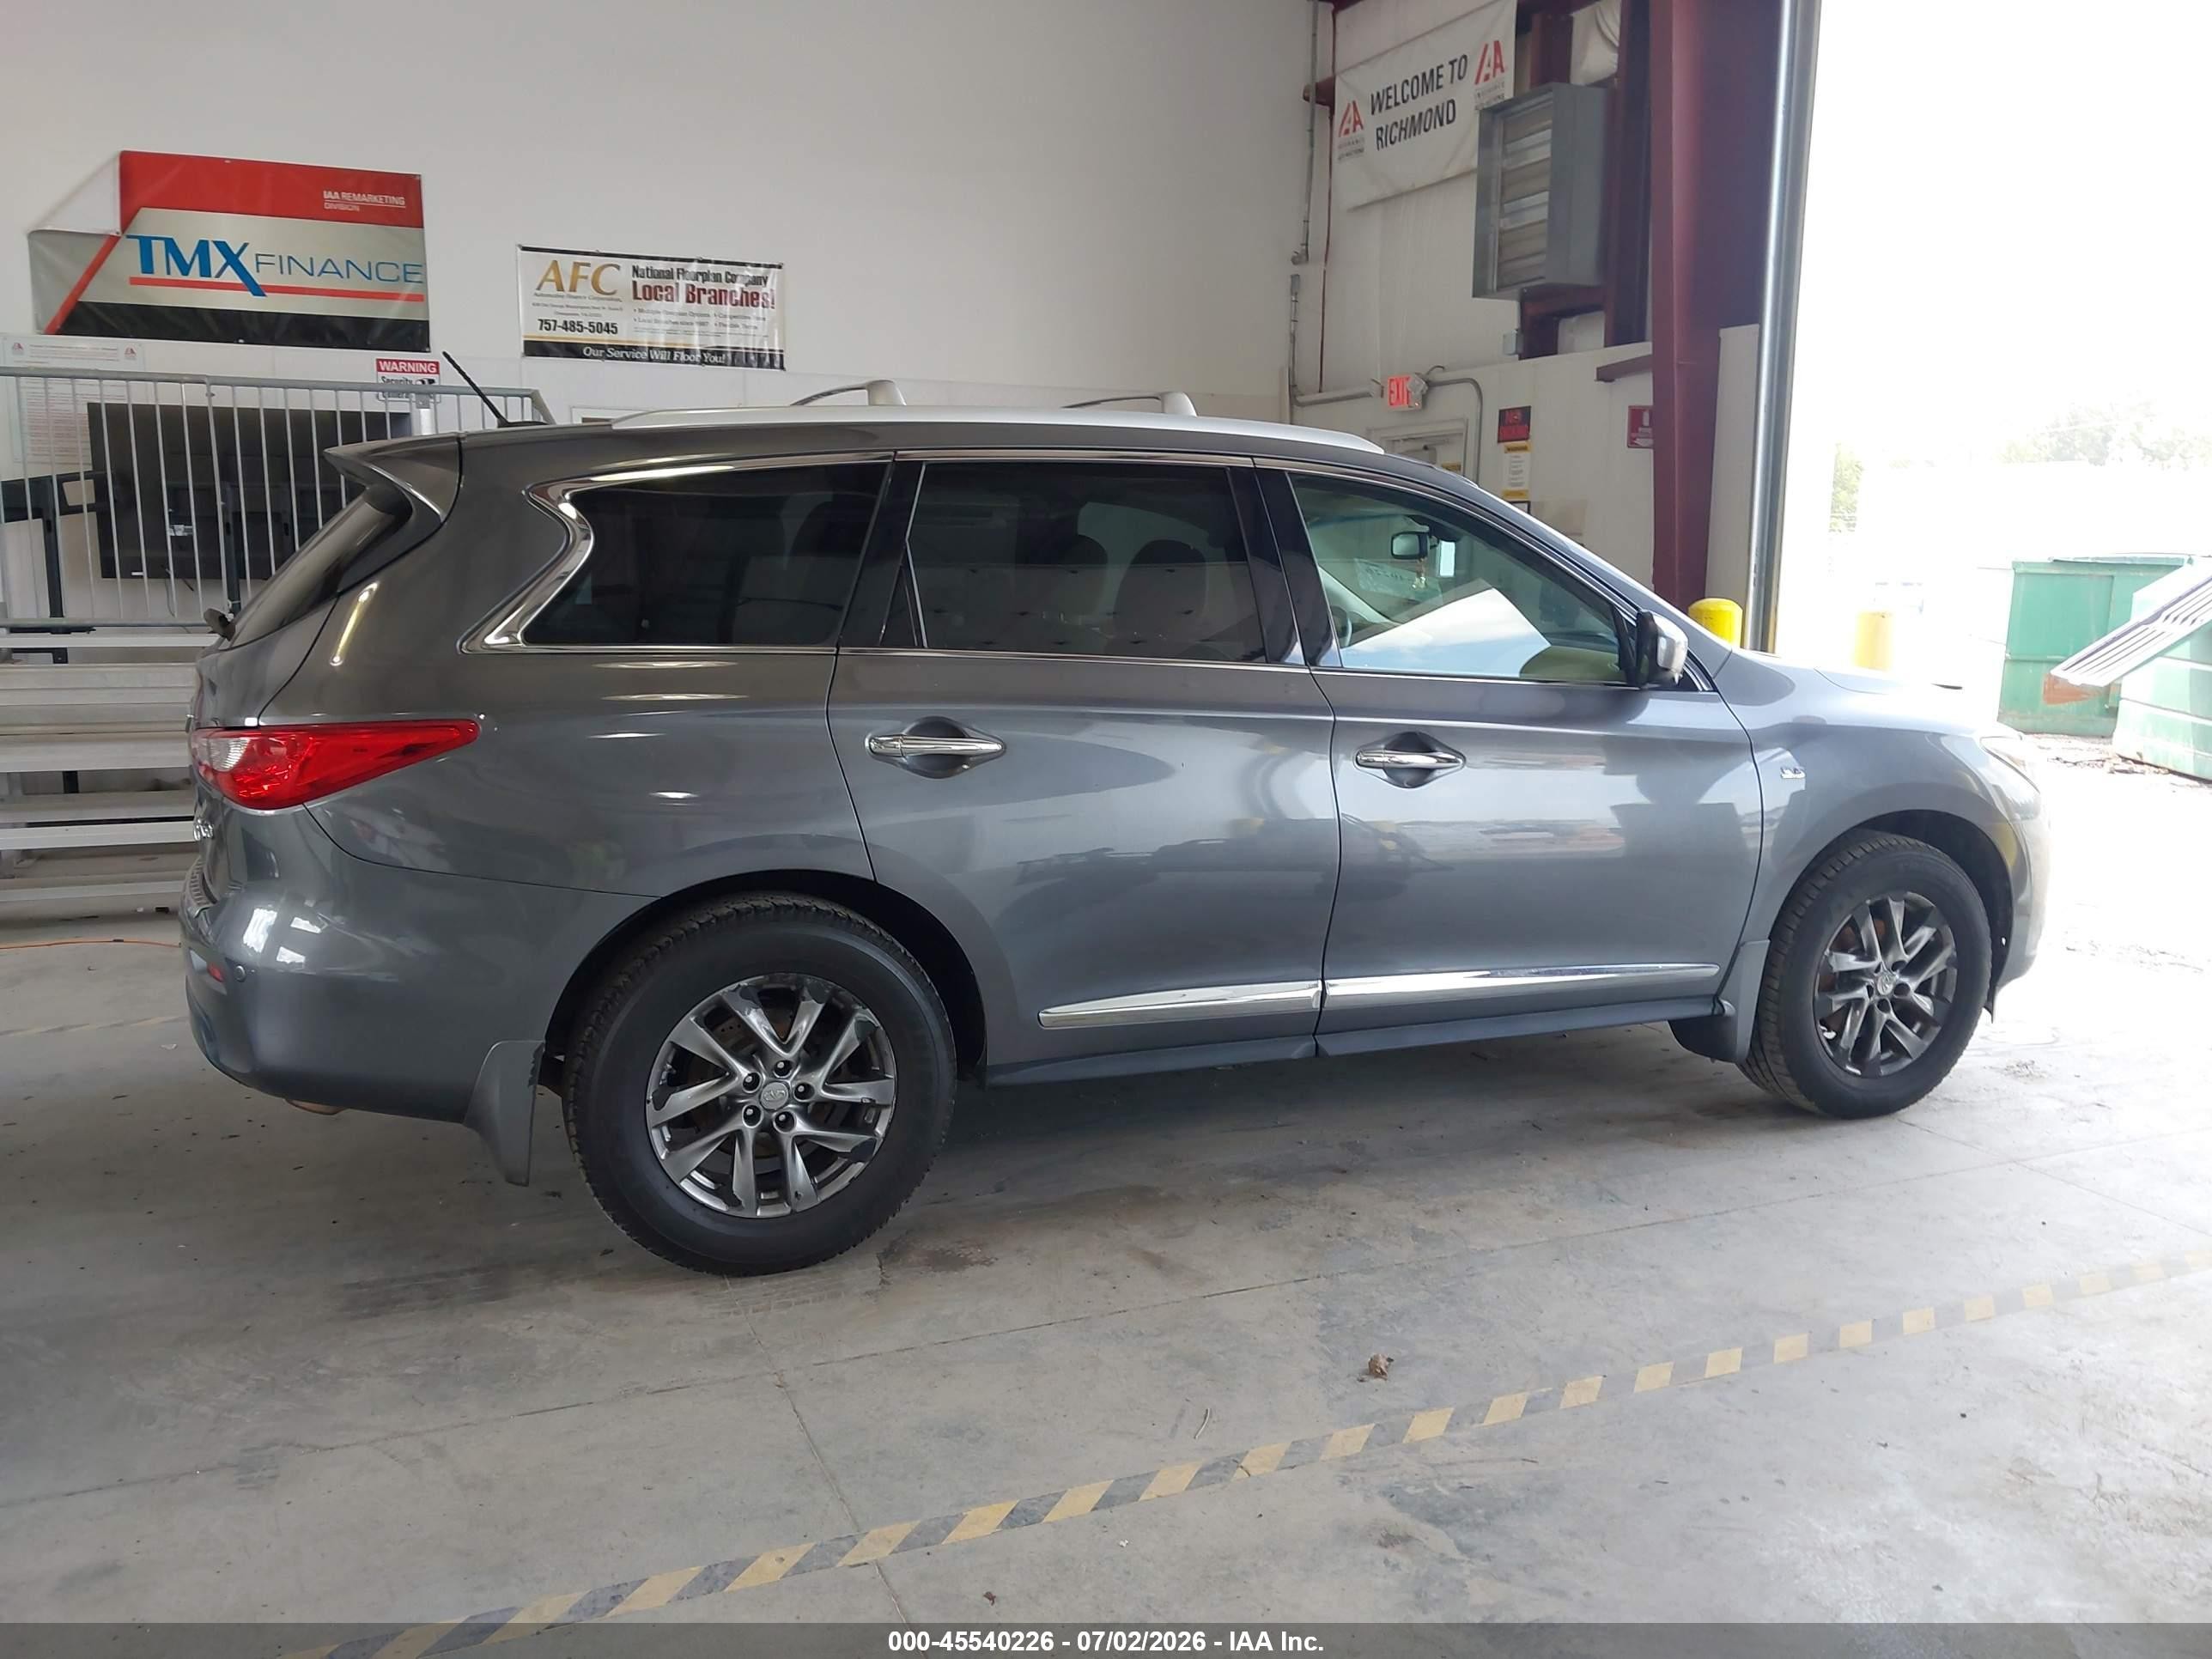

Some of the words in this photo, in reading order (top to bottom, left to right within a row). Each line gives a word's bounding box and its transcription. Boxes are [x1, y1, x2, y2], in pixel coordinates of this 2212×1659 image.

[1370, 64, 1444, 116] WELCOME
[1448, 54, 1468, 84] TO
[1376, 99, 1456, 151] RICHMOND
[323, 191, 341, 200] IAA
[341, 191, 406, 206] REMARKETING
[125, 234, 267, 297] TMX
[254, 252, 423, 284] FINANCE
[536, 259, 621, 296] AFC
[632, 264, 674, 280] National
[725, 270, 769, 289] Copany
[632, 280, 680, 303] Local
[685, 283, 775, 310] Branches!
[538, 319, 618, 335] 757-485-5045
[379, 361, 438, 374] WARNING
[582, 346, 605, 358] Our
[605, 347, 647, 360] Service
[649, 349, 671, 361] Will
[702, 352, 726, 364] You!
